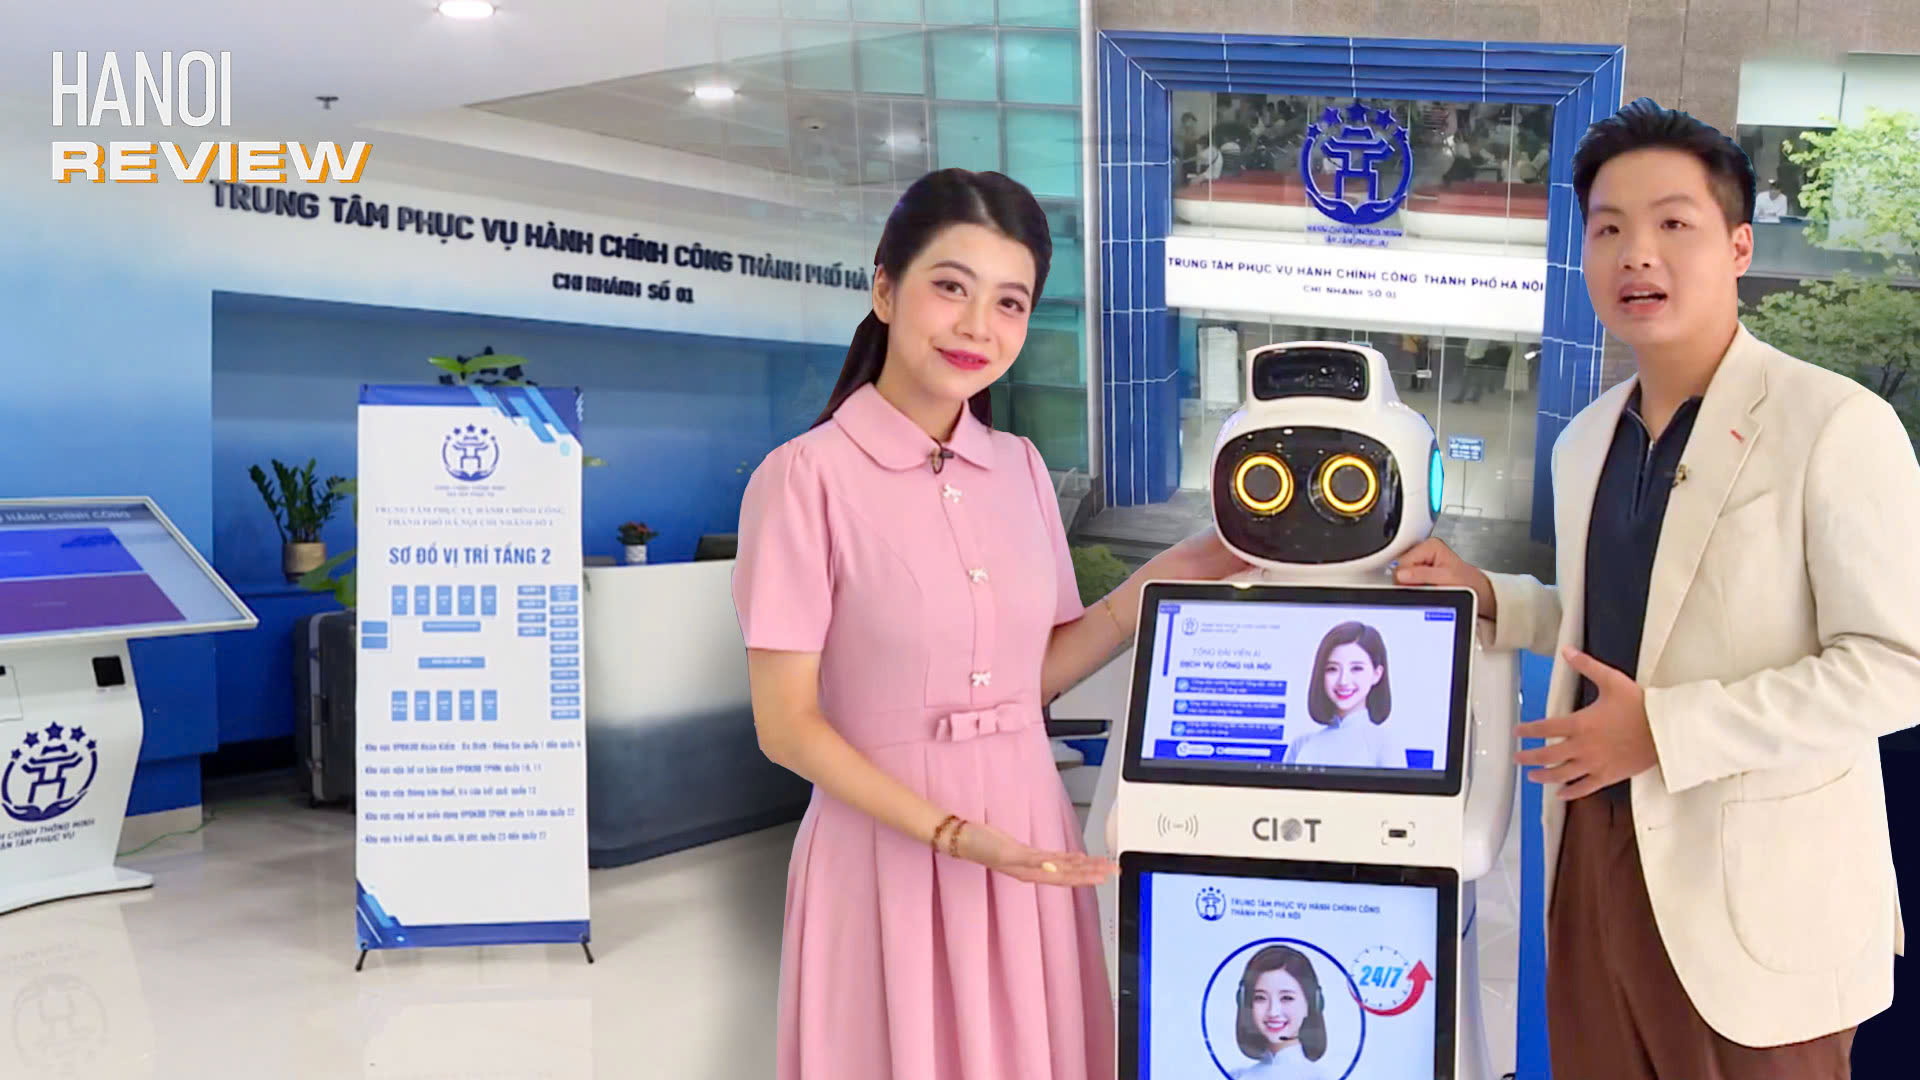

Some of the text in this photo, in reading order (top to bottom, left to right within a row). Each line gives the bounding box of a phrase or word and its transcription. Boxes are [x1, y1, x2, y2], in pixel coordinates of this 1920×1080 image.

[210, 180, 869, 290] TRUNG TÂM PHỤC VỤ HÀNH CHÍNH CÔNG THÀNH PHỐ HÀ
[1168, 257, 1207, 269] TRUNG
[552, 272, 694, 303] CHI NHÁNH SỐ 01
[389, 542, 551, 568] SƠ ĐỒ VỊ TRÍ TẦNG 2
[1359, 965, 1404, 988] 24/7
